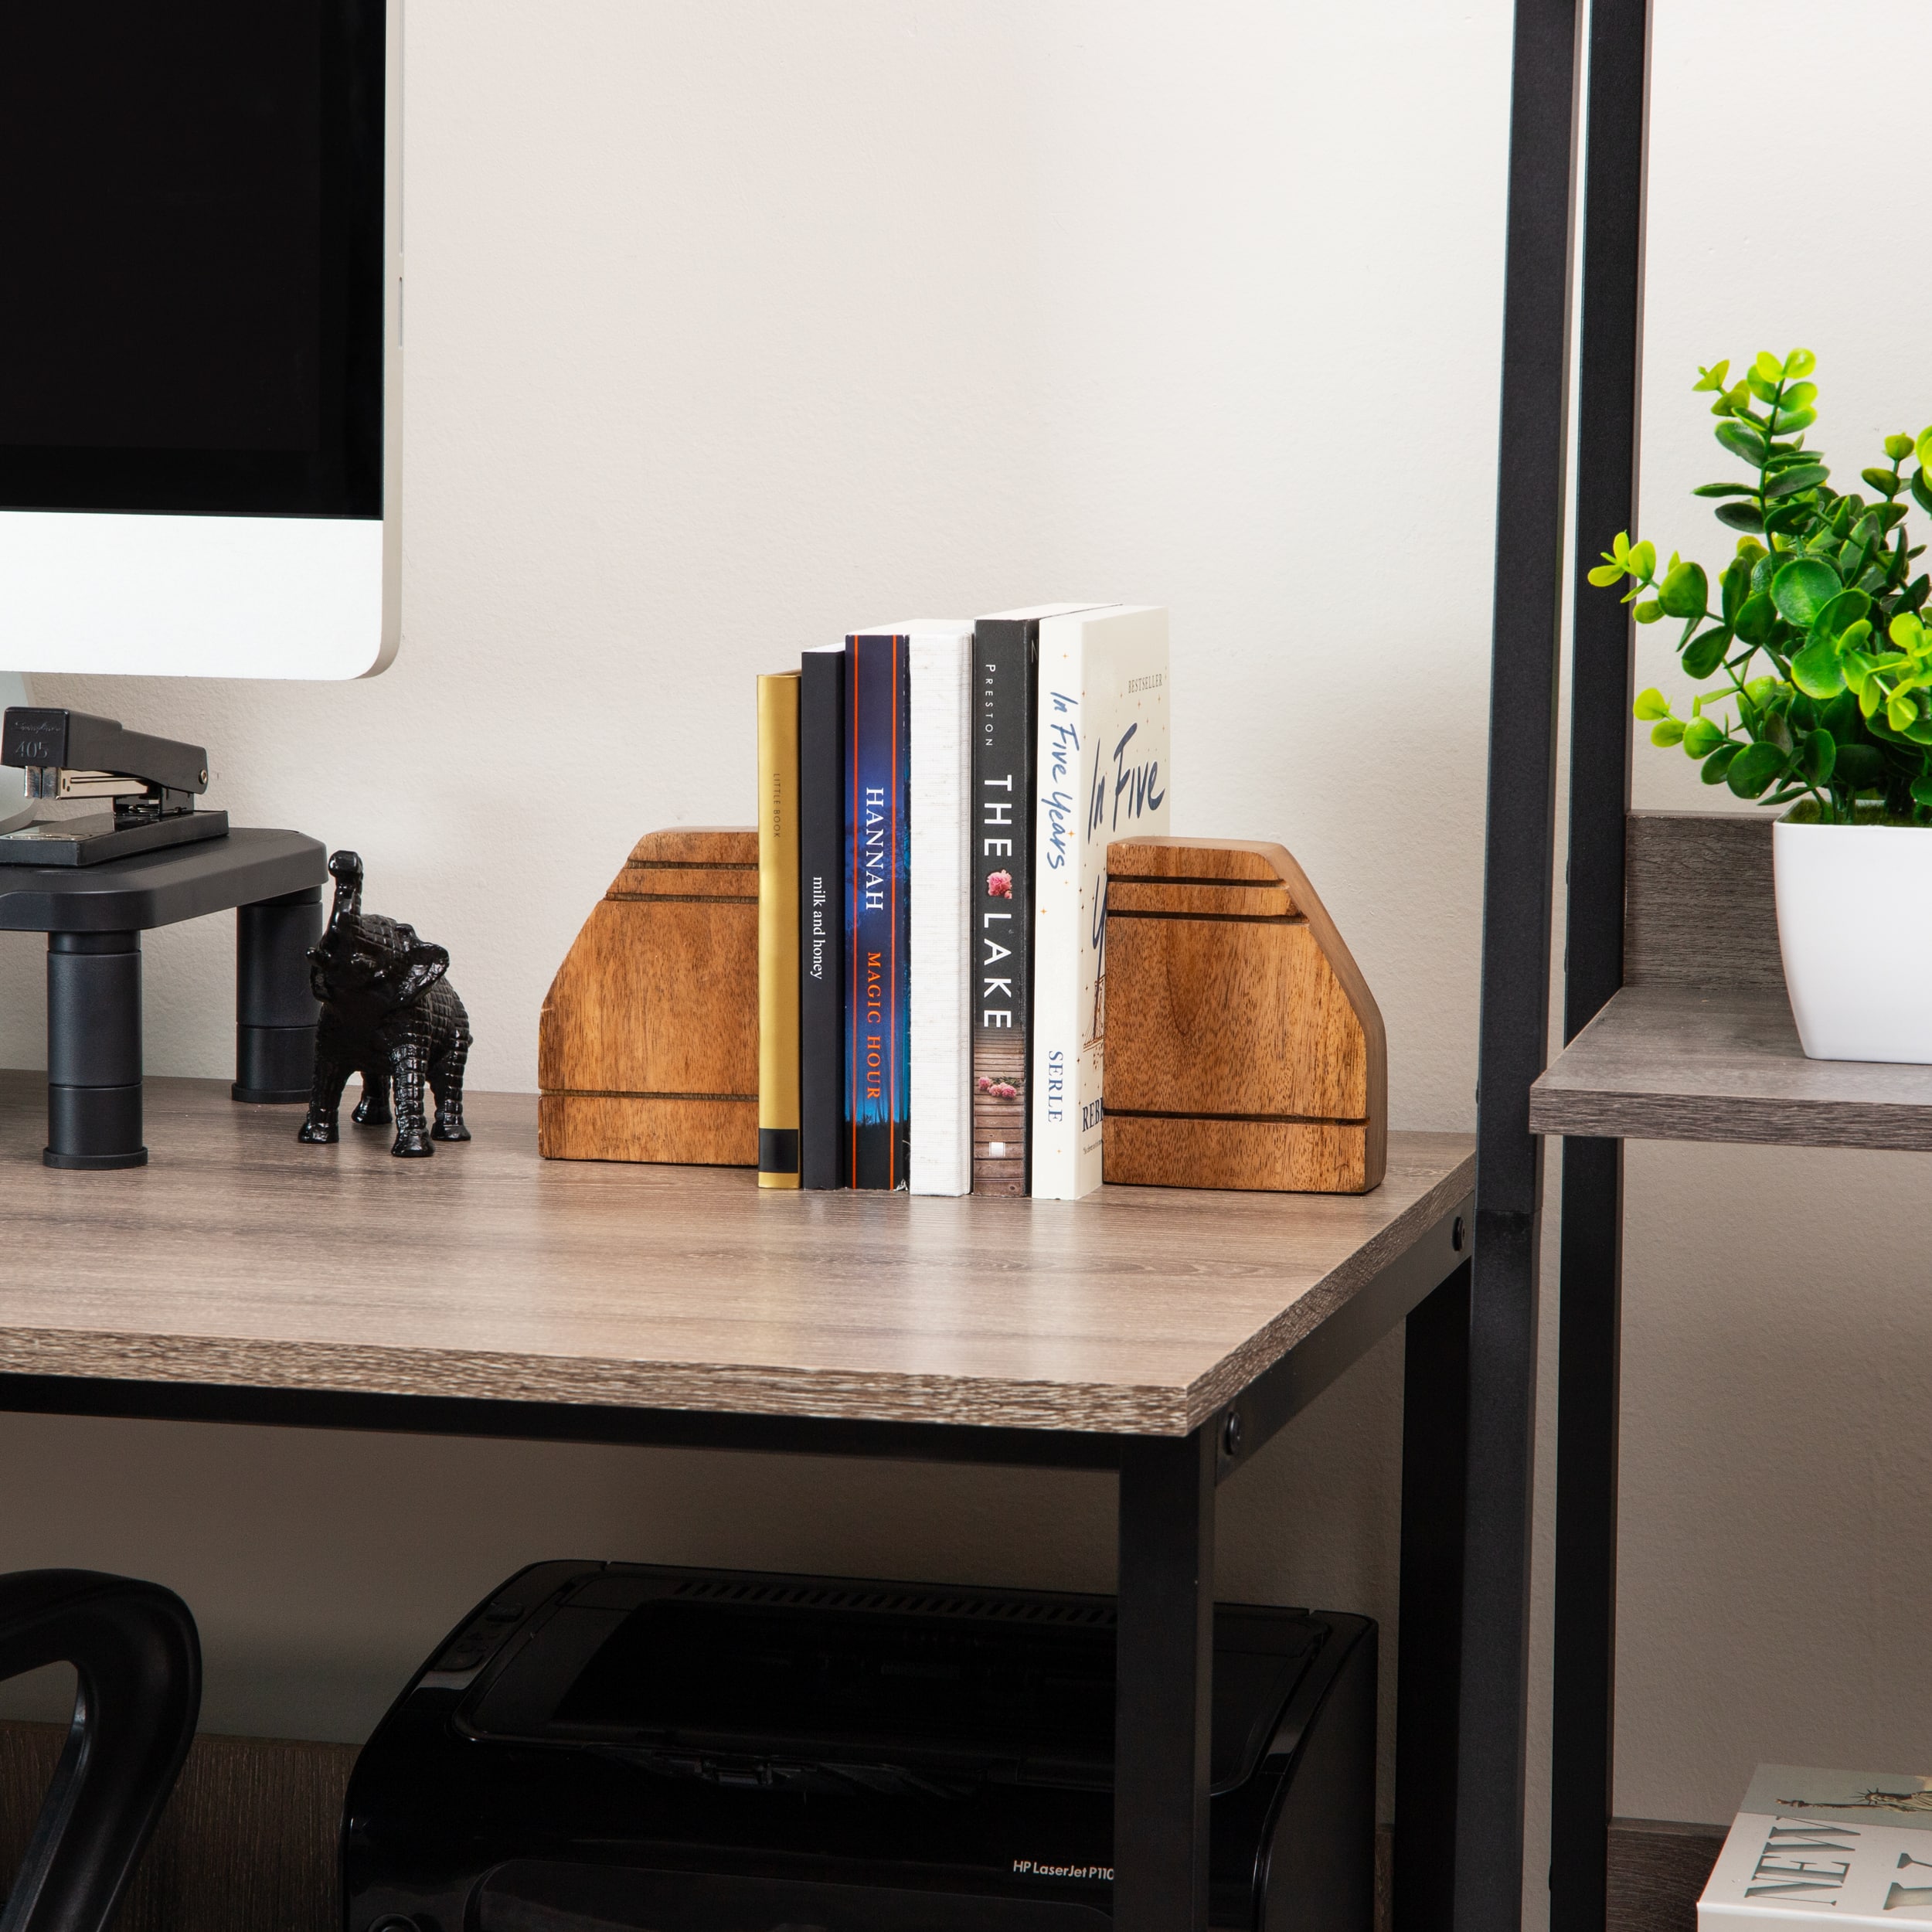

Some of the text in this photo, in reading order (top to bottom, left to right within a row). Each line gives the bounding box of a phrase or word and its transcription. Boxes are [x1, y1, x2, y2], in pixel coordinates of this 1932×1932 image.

[985, 664, 996, 746] PRESTON
[1128, 673, 1163, 694] BESTSELLER
[15, 740, 49, 758] 405
[1041, 692, 1080, 869] In Five Years
[1088, 722, 1165, 845] In Five
[866, 787, 884, 910] HANNAH
[810, 876, 826, 980] milk and honey
[983, 774, 1012, 1029] THE LAKE
[866, 952, 882, 1100] MAGIC HOUR
[1048, 1050, 1064, 1123] SERLE
[1013, 1860, 1032, 1873] HP
[1033, 1862, 1087, 1878] LaserJet
[1743, 1816, 1861, 1906] NEW
